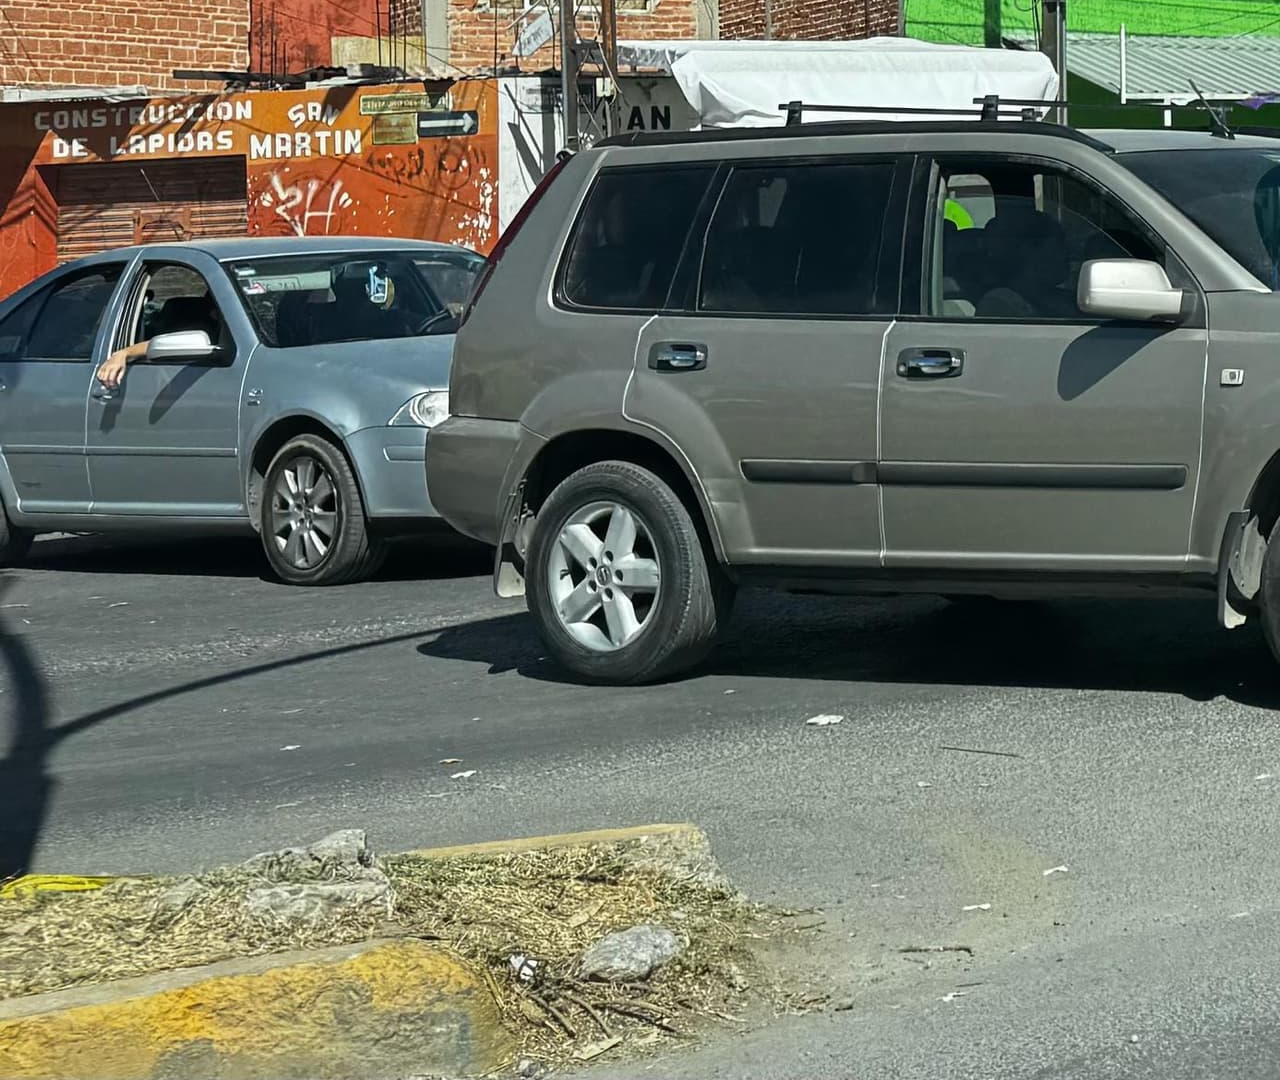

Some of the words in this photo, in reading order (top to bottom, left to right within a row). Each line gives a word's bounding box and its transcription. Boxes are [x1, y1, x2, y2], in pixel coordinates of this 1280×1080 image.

[34, 100, 253, 131] CONSTRUCCION
[287, 102, 338, 128] SAN
[53, 137, 89, 158] DE
[110, 130, 233, 156] LAPIDAS
[250, 129, 362, 160] MARTIN
